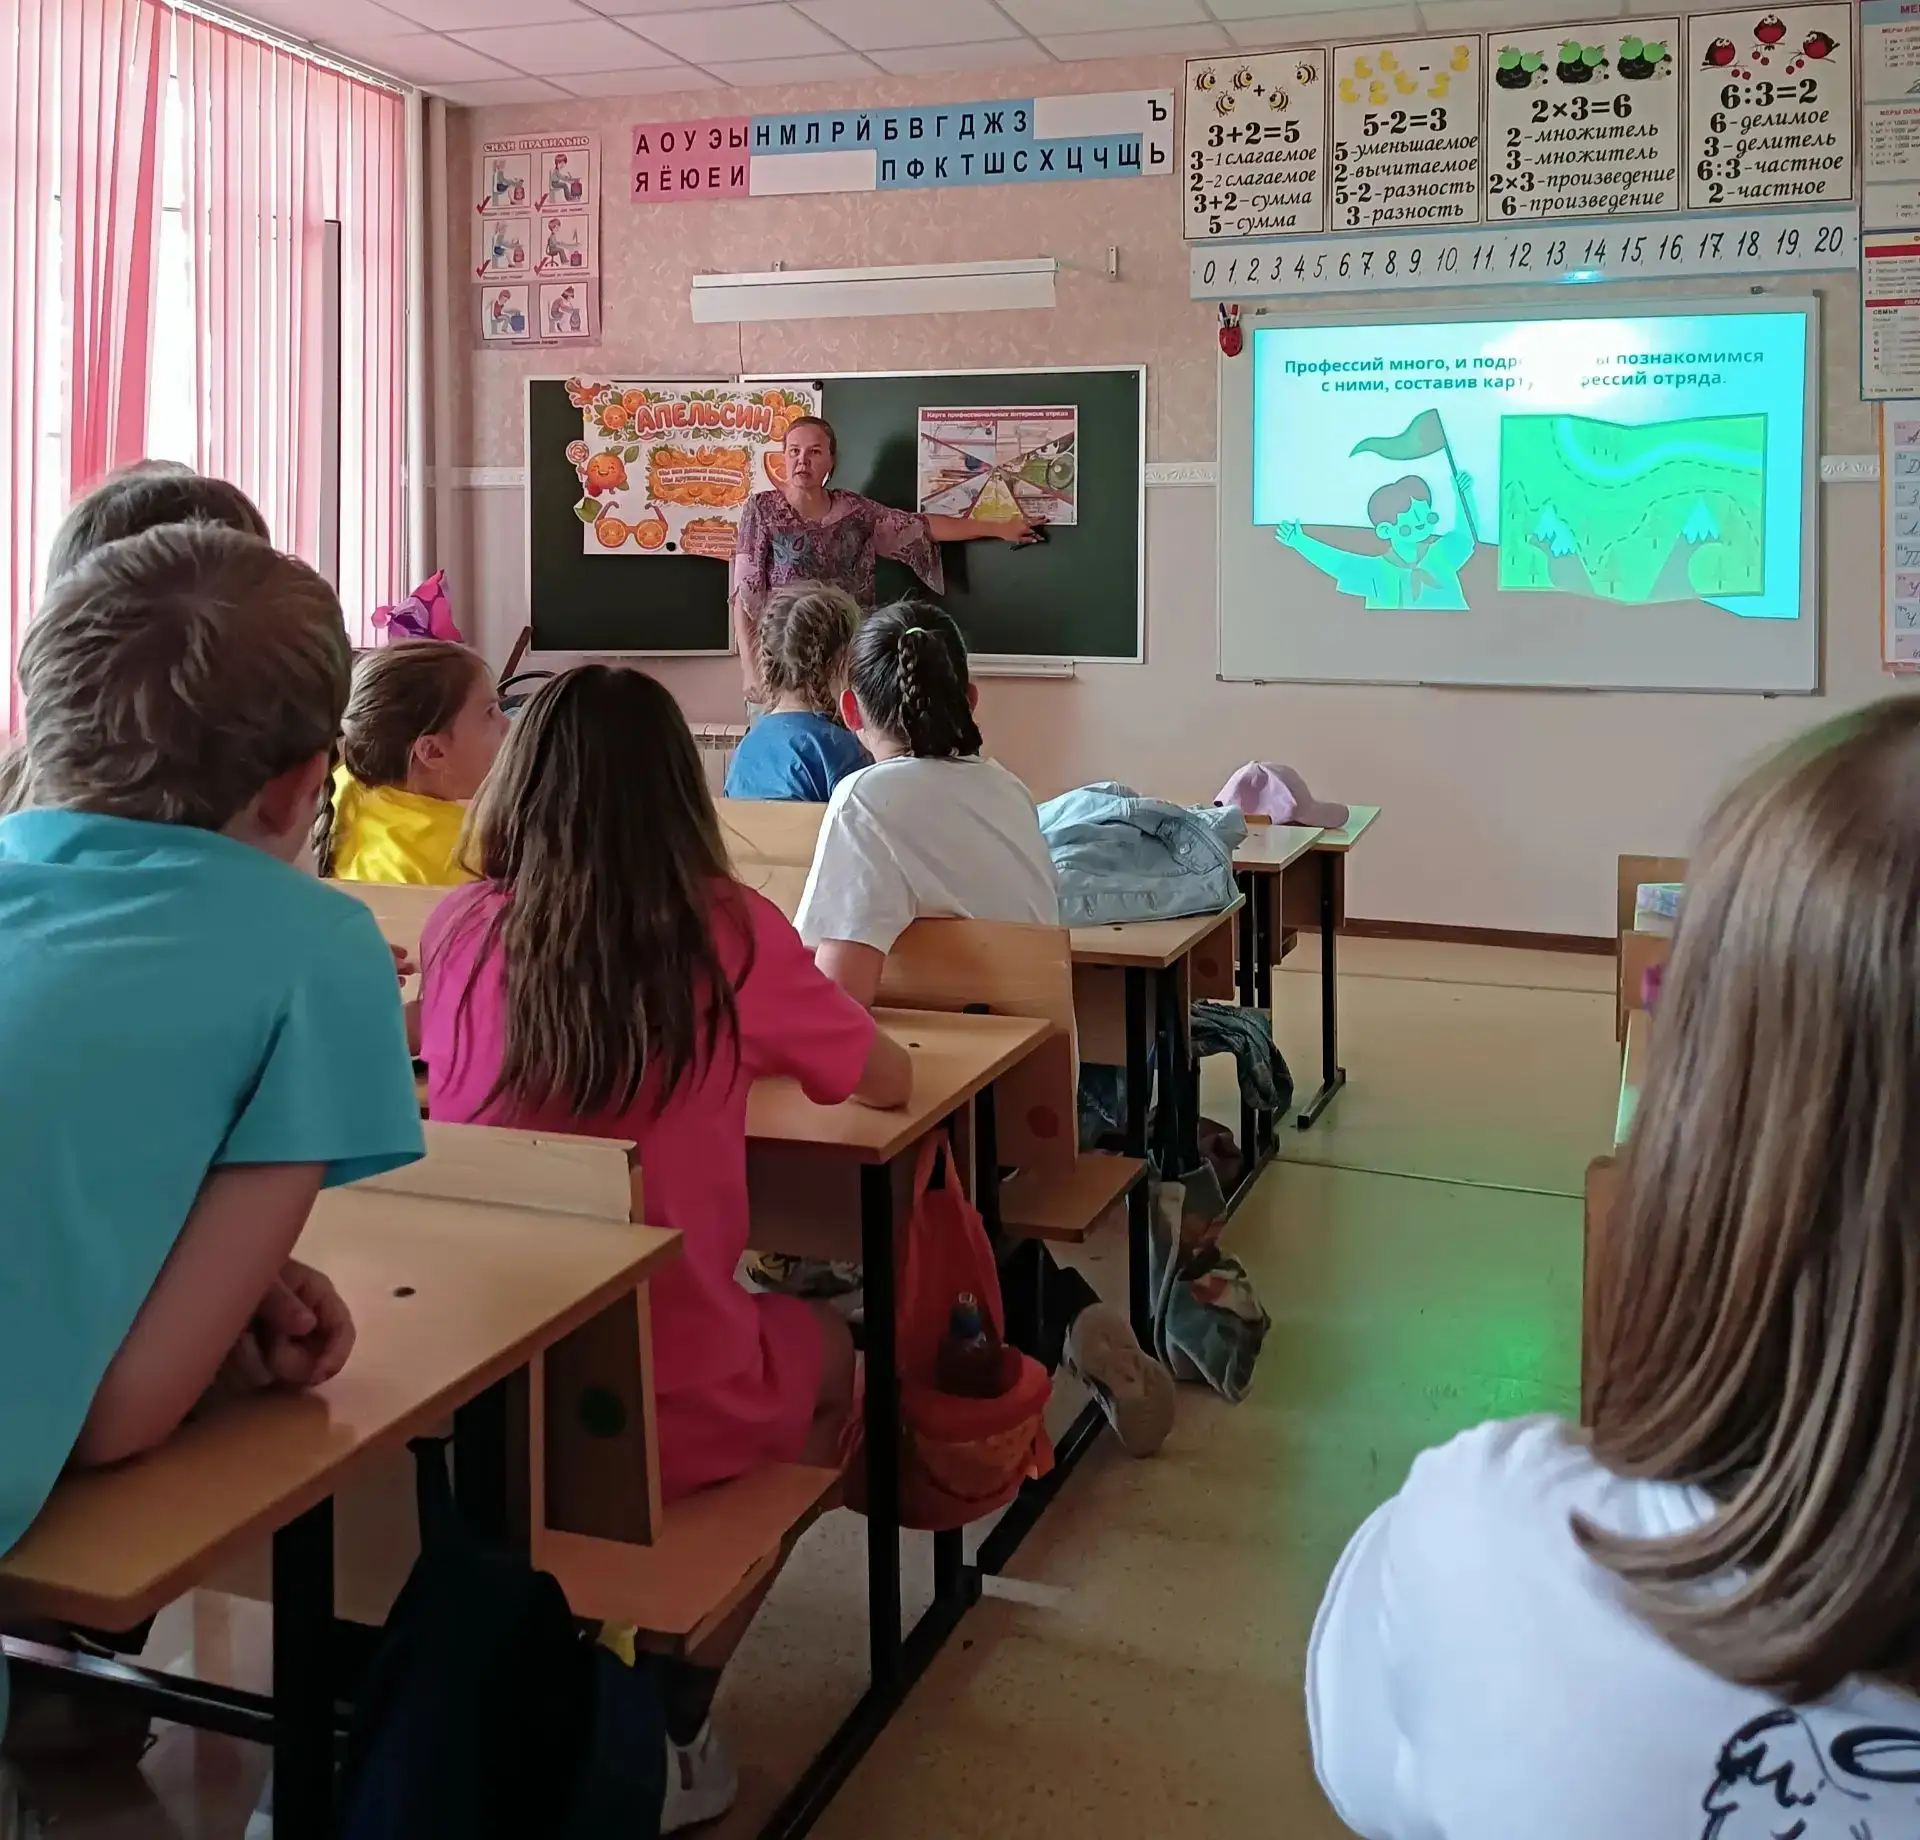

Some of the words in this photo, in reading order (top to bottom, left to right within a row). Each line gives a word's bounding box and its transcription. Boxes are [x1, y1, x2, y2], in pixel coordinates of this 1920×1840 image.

[1721, 78, 1819, 110] 6:3=2
[636, 134, 650, 155] А
[660, 132, 675, 153] О
[684, 130, 697, 151] У
[709, 128, 722, 149] Э
[729, 126, 748, 148] Ы
[757, 125, 770, 146] Н
[780, 124, 796, 145] М
[805, 122, 820, 144] Л
[832, 121, 845, 142] Р
[857, 114, 870, 141] Й
[884, 119, 898, 141] Б
[909, 117, 924, 139] В
[936, 115, 948, 138] Г
[959, 114, 975, 141] Д
[984, 111, 1004, 134] Ж
[1014, 109, 1027, 133] З
[1147, 99, 1167, 122] Ъ
[1207, 120, 1300, 147] 3+2=5
[1363, 107, 1448, 136] 5-2=3
[483, 141, 515, 153] СИДИ
[519, 136, 589, 150] ПРАВИЛЬНО
[635, 172, 649, 193] Я
[660, 165, 672, 191] Ё
[680, 168, 700, 190] Ю
[708, 167, 721, 188] Е
[731, 165, 744, 187] И
[882, 159, 896, 181] П
[906, 158, 924, 180] Ф
[935, 156, 948, 178] К
[961, 154, 975, 176] Т
[984, 152, 1004, 174] Ш
[1013, 150, 1028, 173] С
[1040, 148, 1054, 171] Х
[1067, 147, 1082, 173] Ц
[1094, 147, 1108, 169] Ч
[1118, 143, 1140, 169] Щ
[1150, 142, 1165, 164] Ь
[1285, 358, 1384, 376] Профессий
[1389, 358, 1450, 372] много,
[1455, 359, 1467, 369] и
[1617, 351, 1764, 365] познакомимся
[1321, 380, 1329, 392] с
[1335, 379, 1389, 393] ними,
[1394, 377, 1477, 391] составив
[1653, 372, 1727, 388] отряда.
[634, 402, 773, 435] АПЕЛЬСИН
